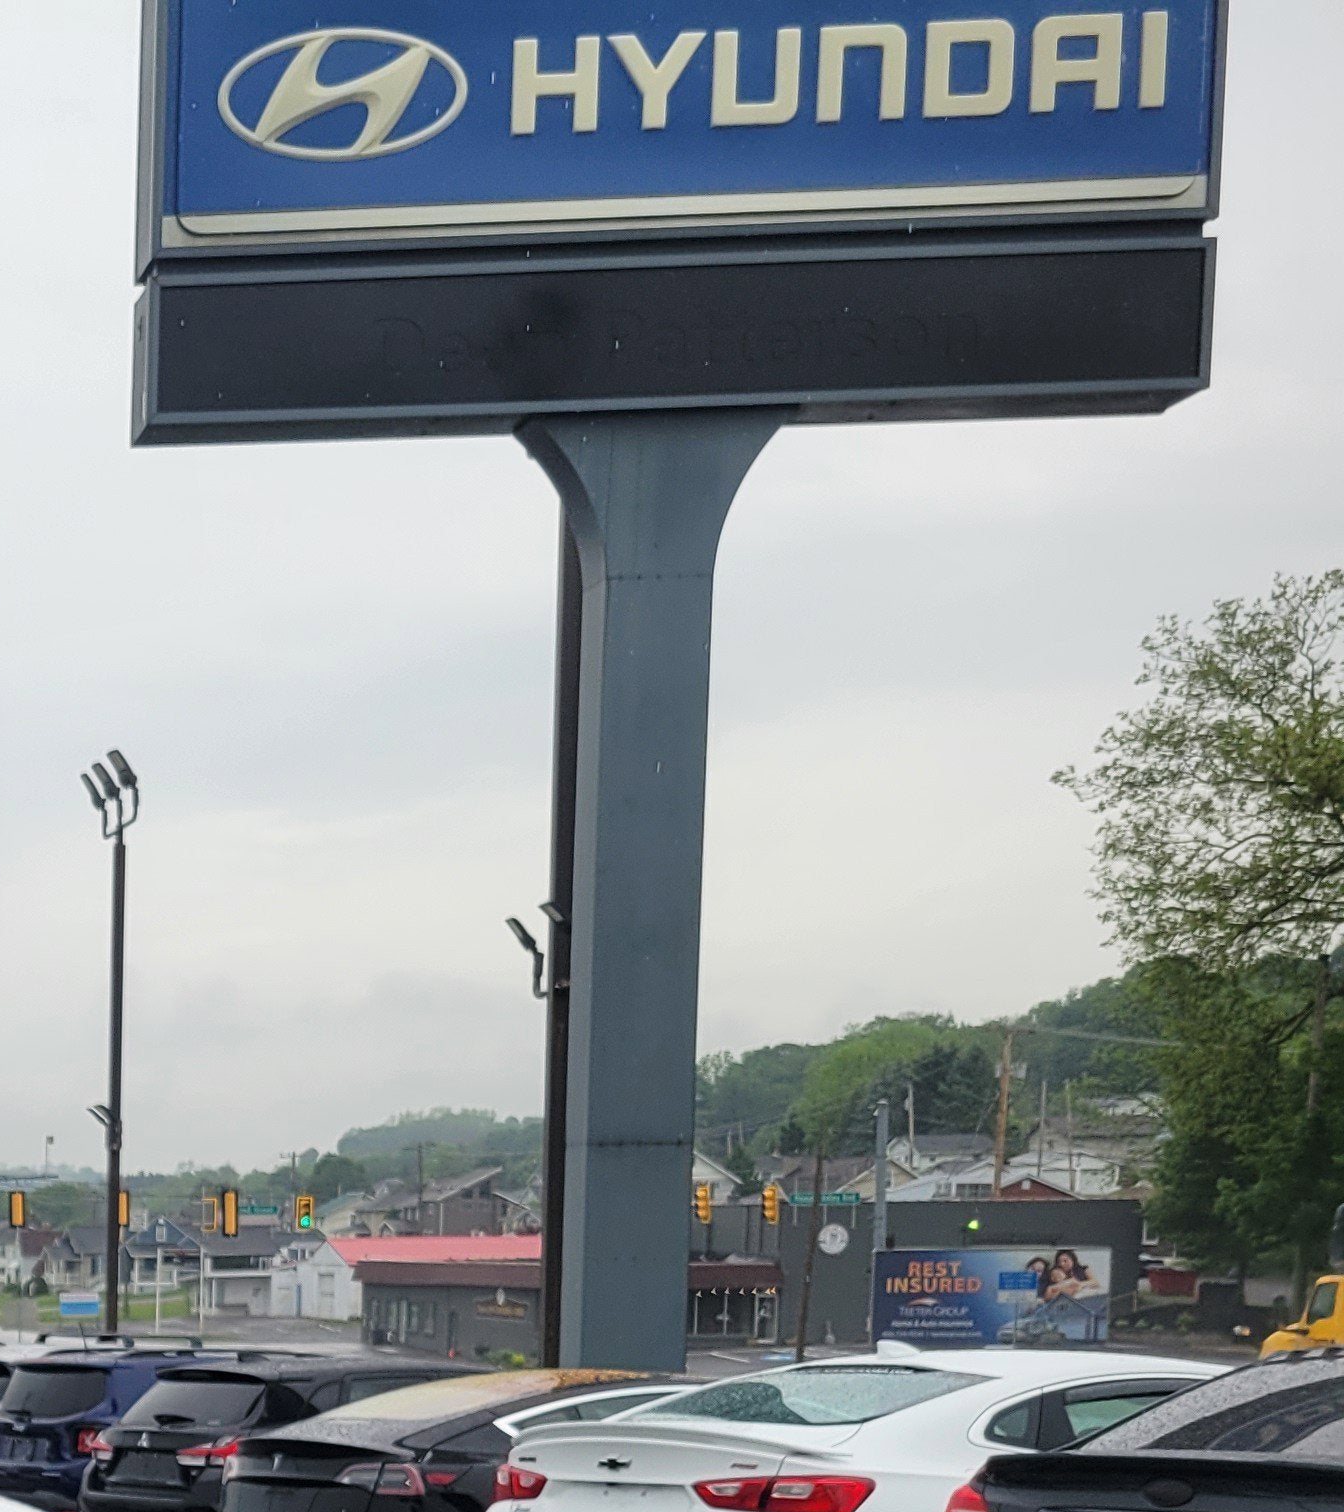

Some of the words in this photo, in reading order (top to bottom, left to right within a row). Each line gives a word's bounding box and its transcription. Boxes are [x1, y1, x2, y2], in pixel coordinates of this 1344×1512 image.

[510, 11, 1169, 136] HYUNDAI
[907, 1260, 962, 1278] REST
[885, 1277, 983, 1294] INSURED
